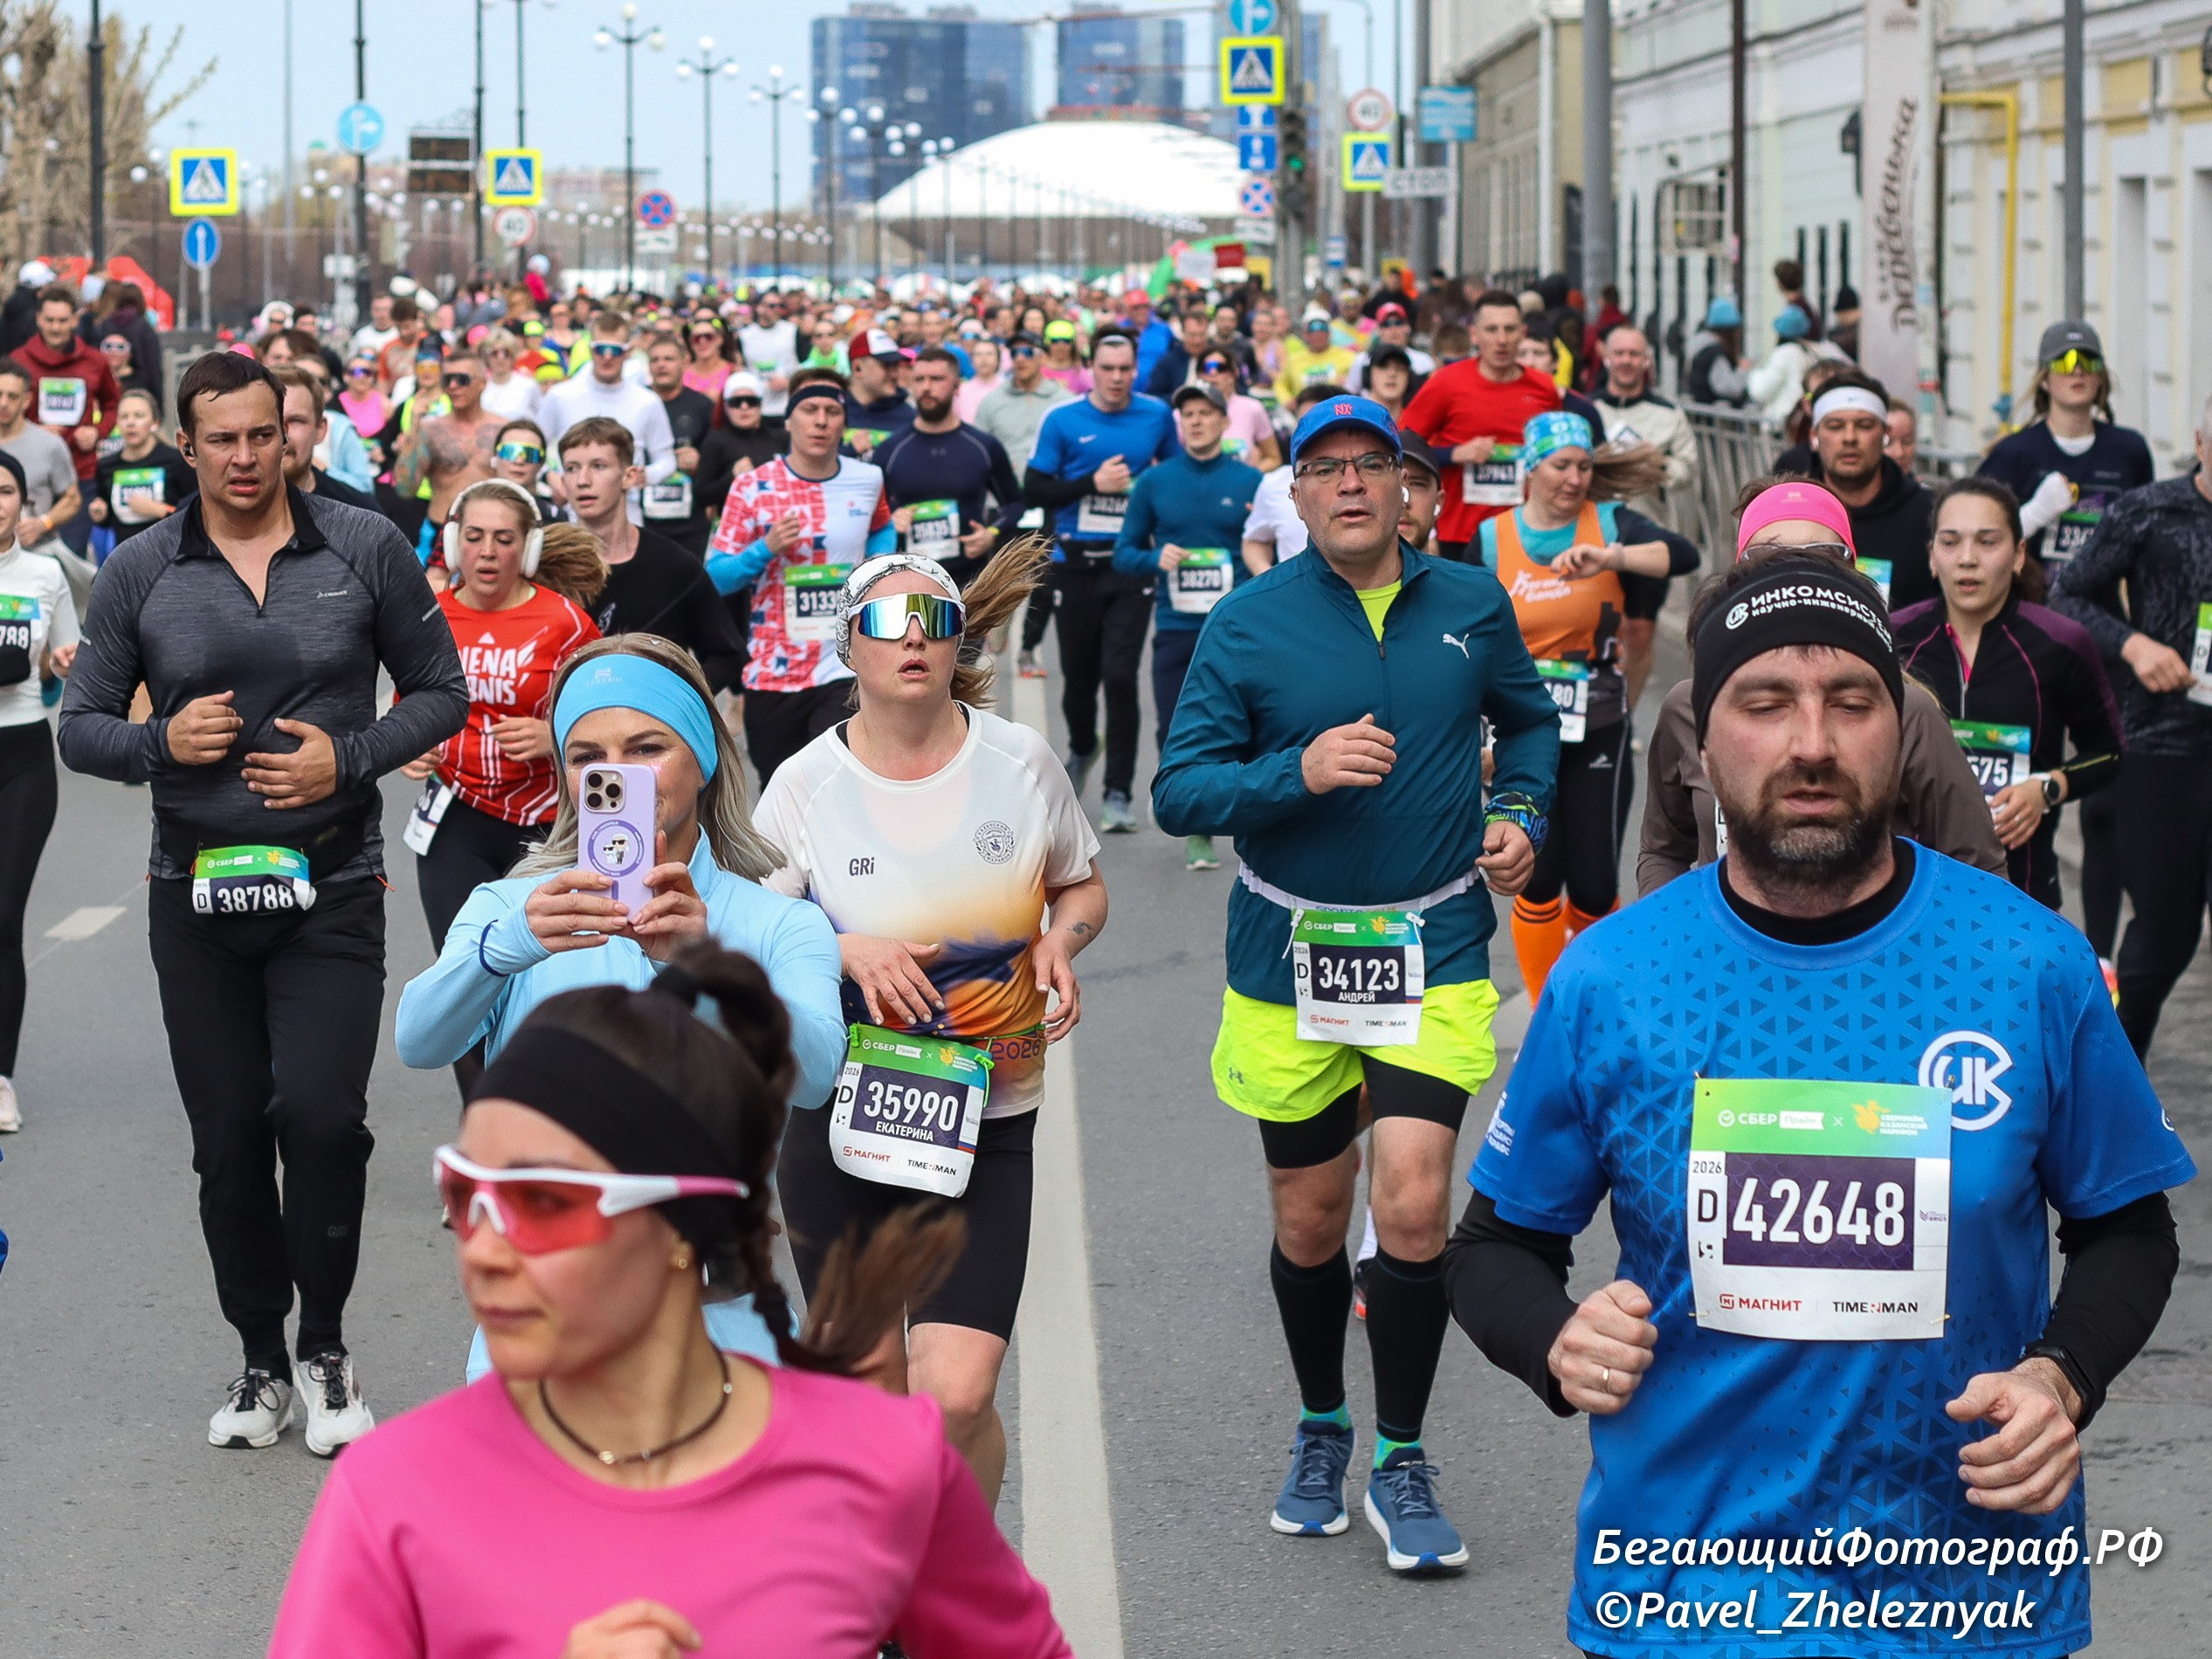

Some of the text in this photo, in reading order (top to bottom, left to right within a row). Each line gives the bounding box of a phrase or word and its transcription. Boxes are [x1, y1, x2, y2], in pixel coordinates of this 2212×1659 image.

[799, 590, 837, 612] 3133
[196, 892, 208, 909] D
[217, 884, 293, 913] 38788
[1297, 962, 1309, 980] D
[1319, 957, 1400, 992] 34123
[1338, 990, 1375, 1003] АНДРЕЙ
[873, 1041, 896, 1052] СБЕР
[844, 1066, 860, 1077] 2026
[837, 1084, 854, 1105] D
[863, 1081, 959, 1132] 35990
[1738, 1112, 1778, 1126] СБЕР
[875, 1120, 934, 1142] ЕКАТЕРИНА
[854, 1149, 892, 1163] МАГНИТ
[1692, 1160, 1723, 1174] 2026
[1698, 1188, 1719, 1223] D
[1733, 1178, 1905, 1246] 42648
[1739, 1298, 1802, 1311] МАГНИТ
